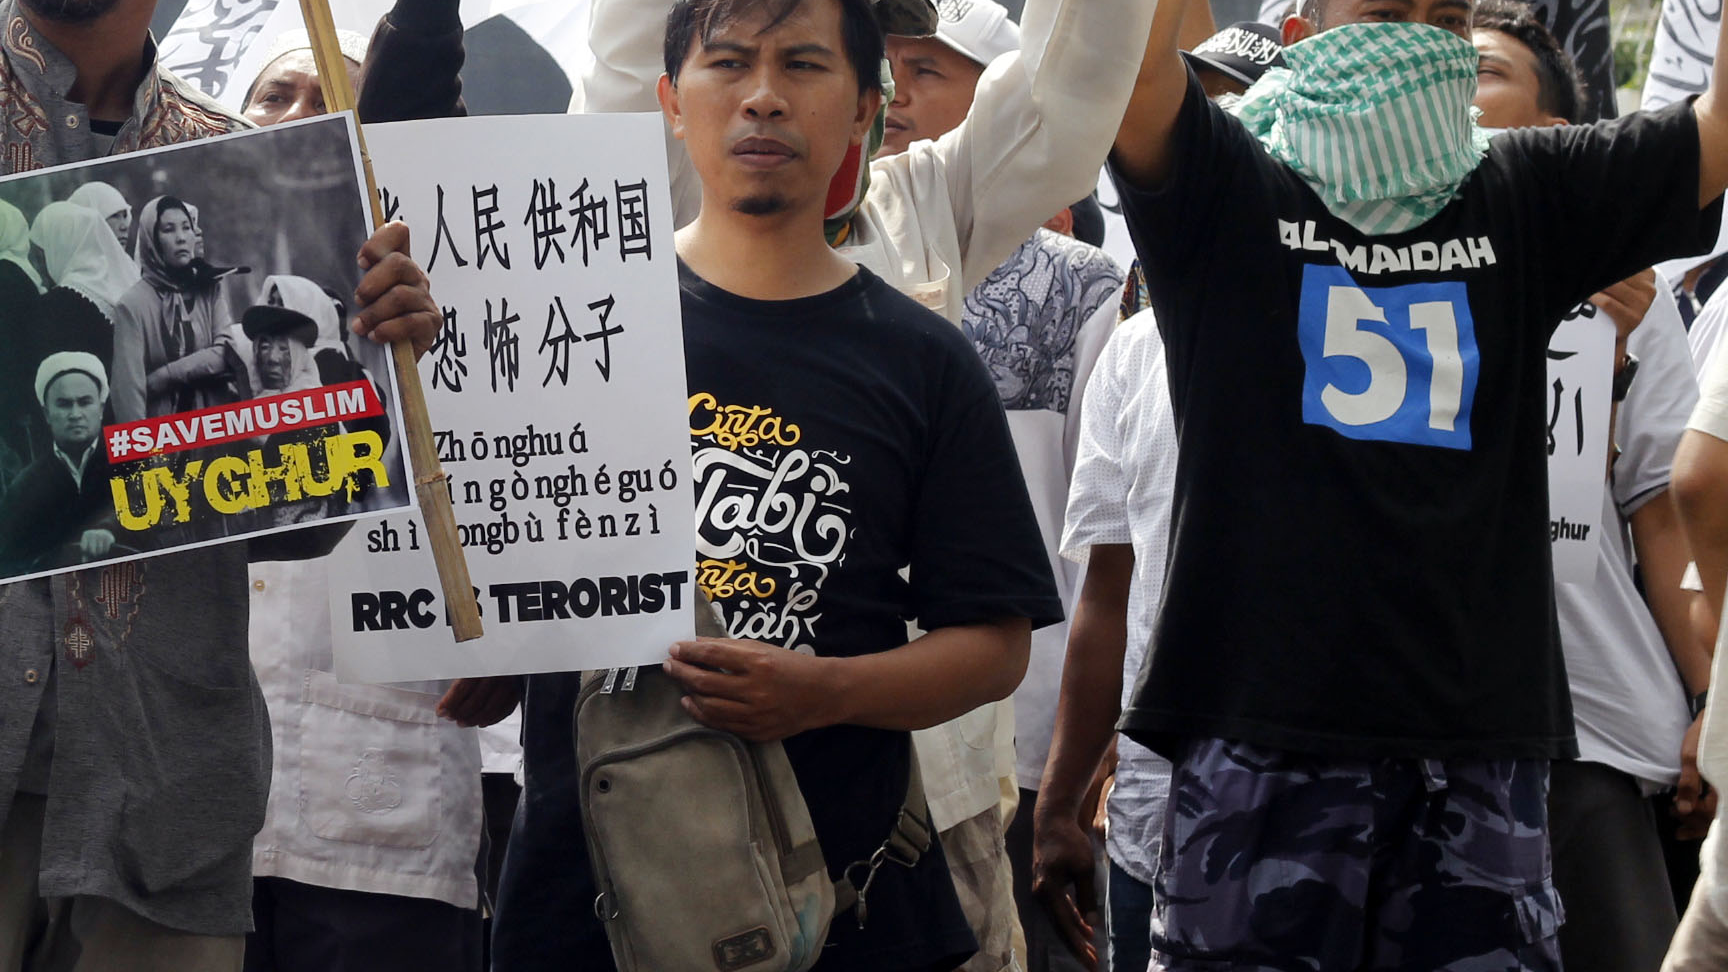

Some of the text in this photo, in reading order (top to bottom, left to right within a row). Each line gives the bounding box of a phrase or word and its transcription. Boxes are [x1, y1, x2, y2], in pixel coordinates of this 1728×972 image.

[378, 177, 653, 274] 人民供和国
[1321, 285, 1464, 431] 51
[109, 387, 367, 457] #SAVEMUSLIM
[688, 392, 801, 451] Cinta
[109, 429, 390, 531] UYGHUR
[1550, 516, 1590, 542] ghur
[351, 587, 437, 632] RRC
[489, 570, 689, 623] TERORIST
[695, 559, 776, 601] inta
